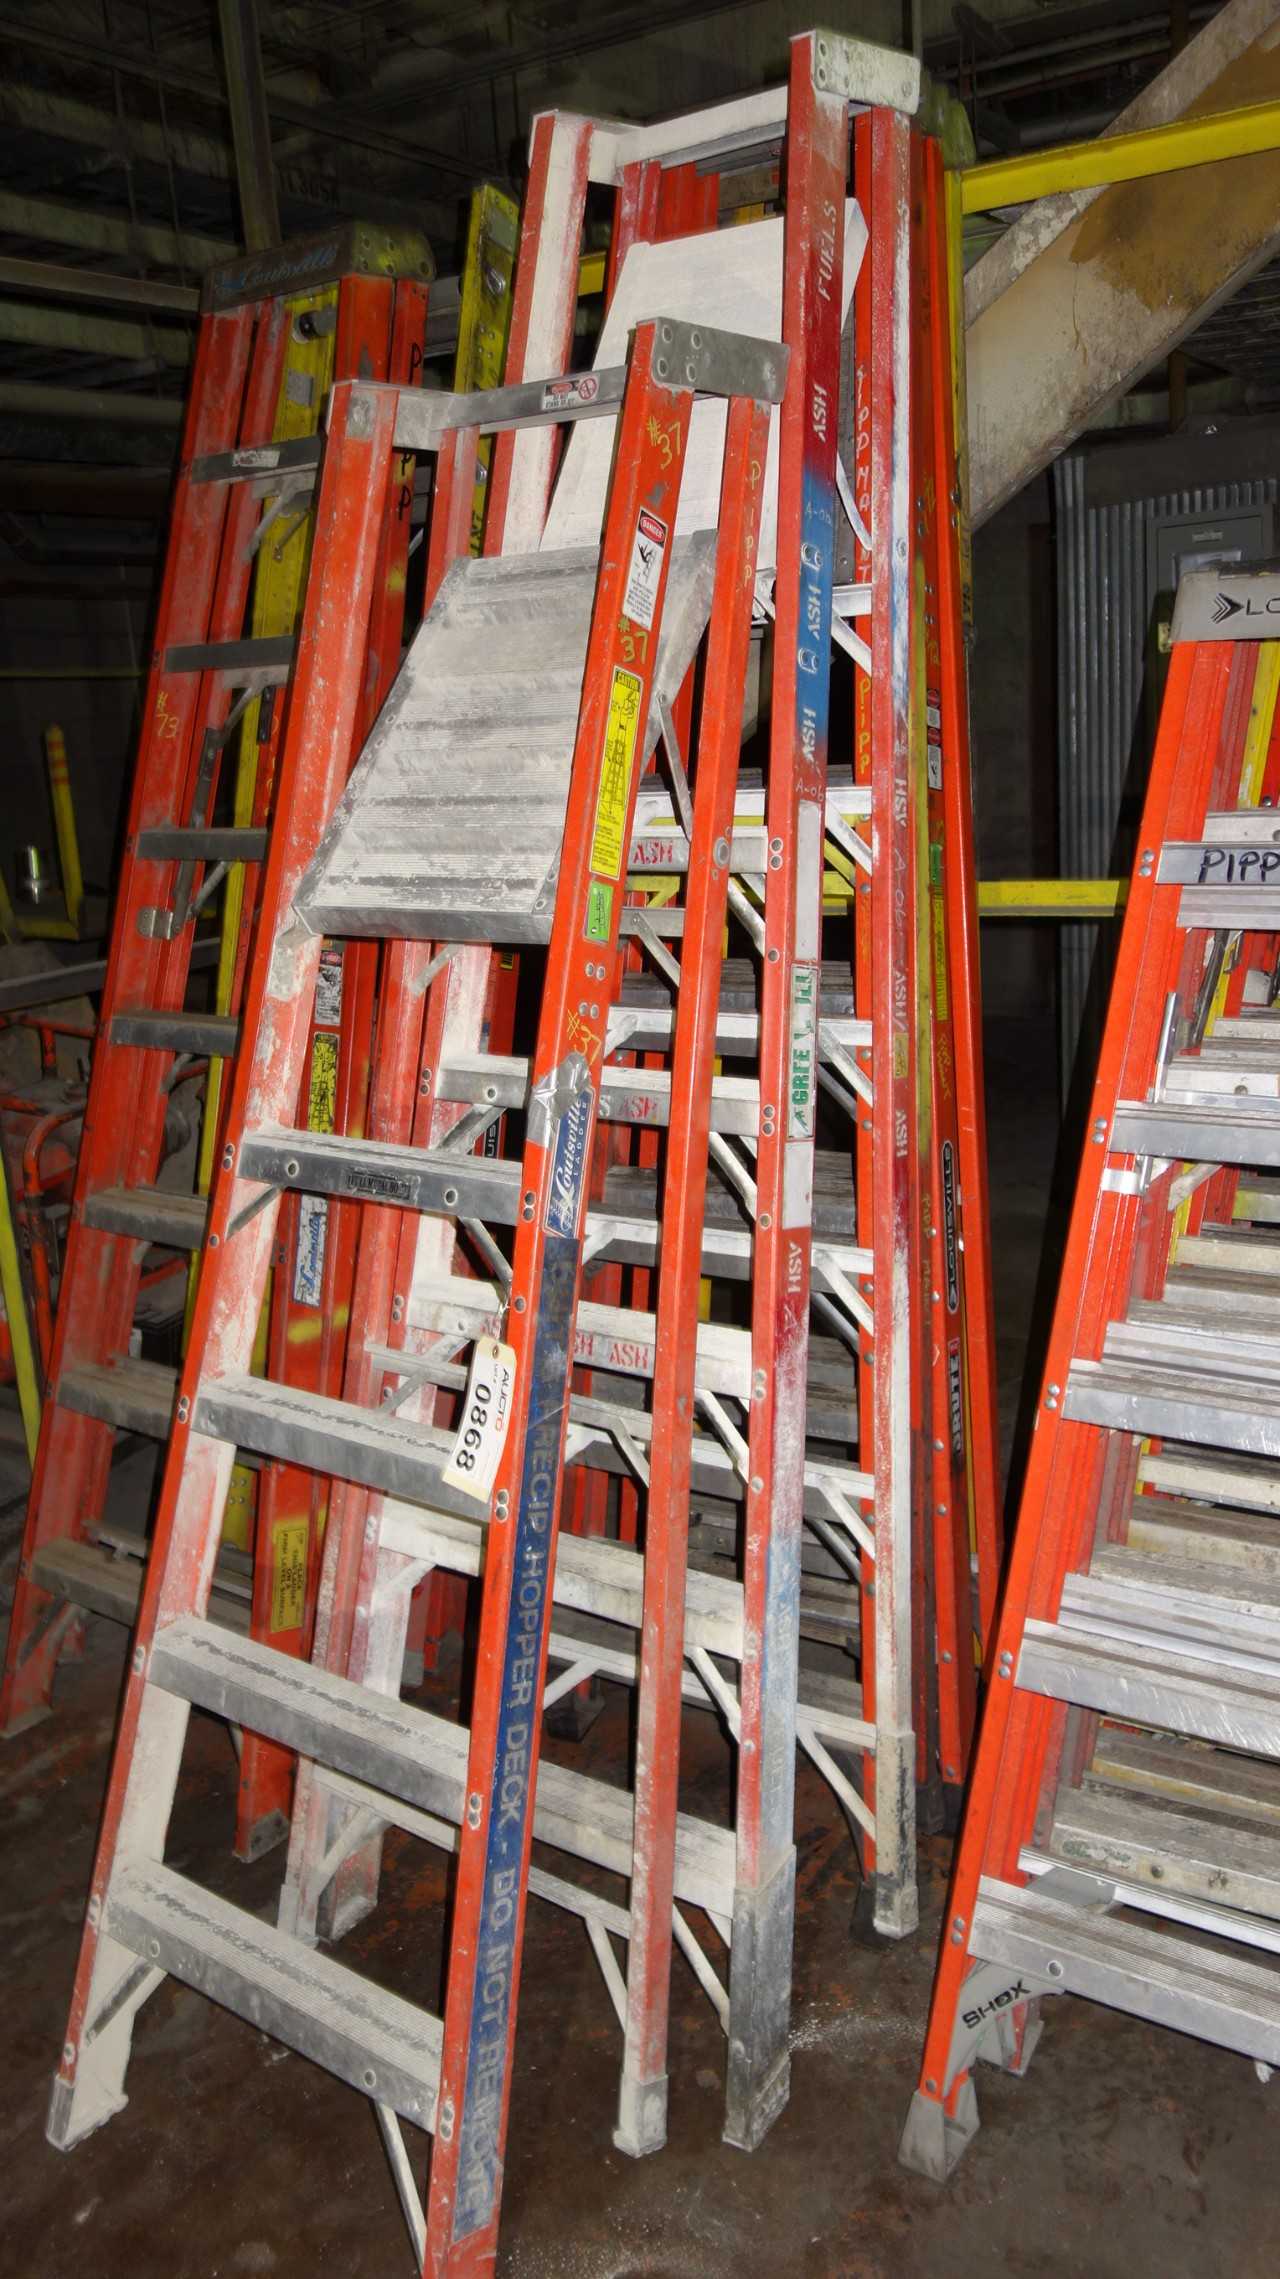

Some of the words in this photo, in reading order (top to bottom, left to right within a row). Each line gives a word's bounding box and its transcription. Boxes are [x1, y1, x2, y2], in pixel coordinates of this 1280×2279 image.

[813, 384, 828, 442] ASH
[808, 585, 822, 640] ASH
[802, 707, 817, 762] ASH
[633, 841, 674, 864] ASH
[1198, 849, 1280, 883] PIPP
[555, 1095, 584, 1193] Louisville
[895, 1110, 908, 1157] ASH
[944, 1147, 956, 1283] LOUISVILLE
[788, 1242, 802, 1293] ASH
[609, 1343, 648, 1369] ASH
[456, 1383, 491, 1472] 0868
[495, 1368, 510, 1432] AUCTO
[511, 1551, 544, 1706] HOPPER
[501, 1725, 528, 1826] DECK
[490, 1870, 516, 1930] DO
[481, 1944, 509, 2023] NOT
[962, 1979, 1031, 2029] SHOX
